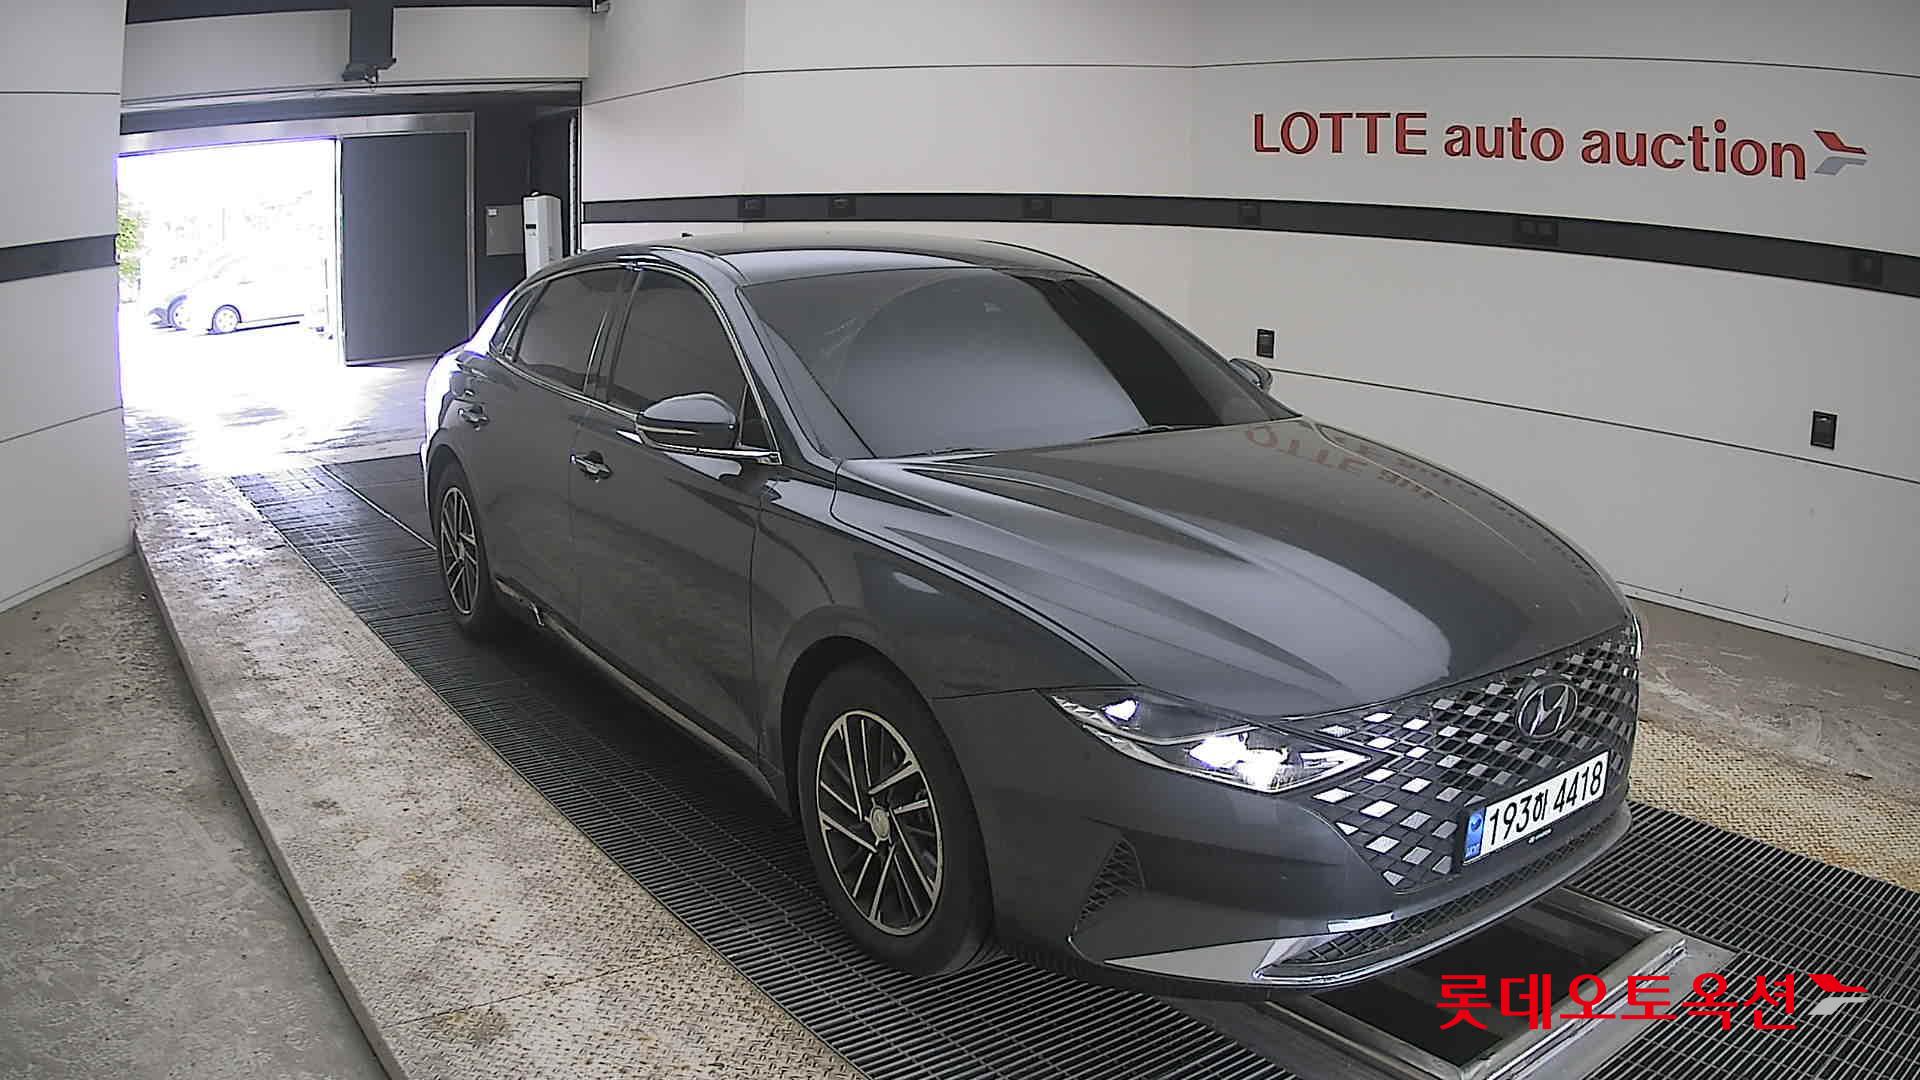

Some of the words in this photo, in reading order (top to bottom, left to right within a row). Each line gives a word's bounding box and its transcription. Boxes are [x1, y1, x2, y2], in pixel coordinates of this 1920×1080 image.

[1253, 112, 1428, 155] LOTTE
[1444, 116, 1565, 162] auto
[1580, 119, 1807, 180] auction
[1552, 760, 1604, 813] 4418
